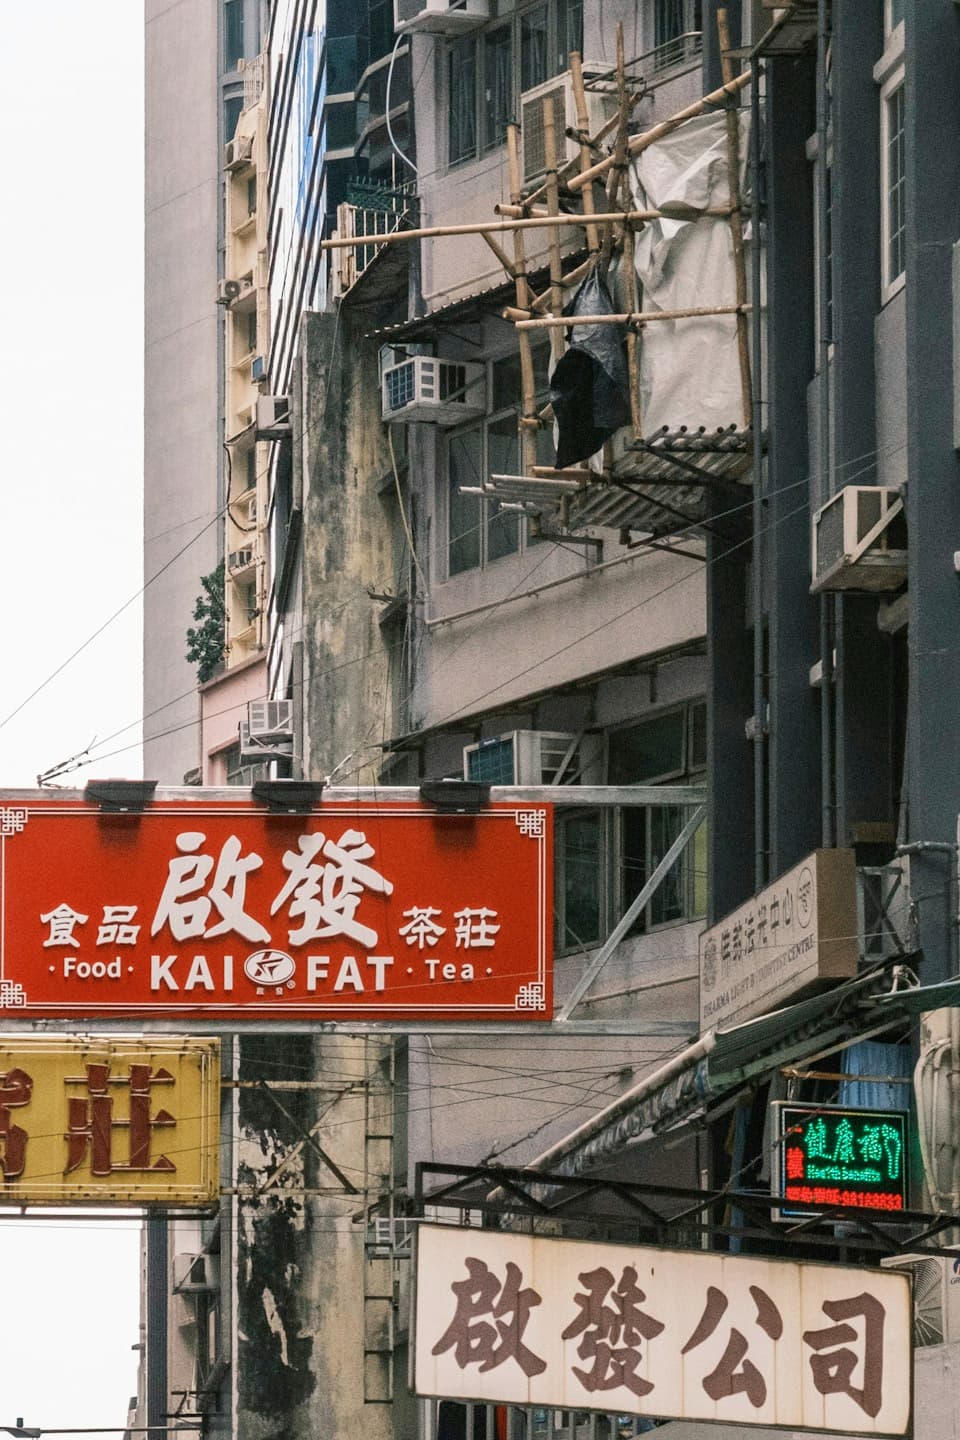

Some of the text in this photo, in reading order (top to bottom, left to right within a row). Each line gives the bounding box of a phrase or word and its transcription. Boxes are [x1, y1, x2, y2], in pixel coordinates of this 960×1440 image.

[150, 829, 394, 949] 啟發
[40, 903, 140, 948] 食品
[400, 906, 501, 950] 茶莊
[63, 956, 121, 979] Food
[151, 955, 394, 991] KAI FAT
[426, 958, 475, 980] Tea
[431, 1257, 886, 1418] 啟發公司
